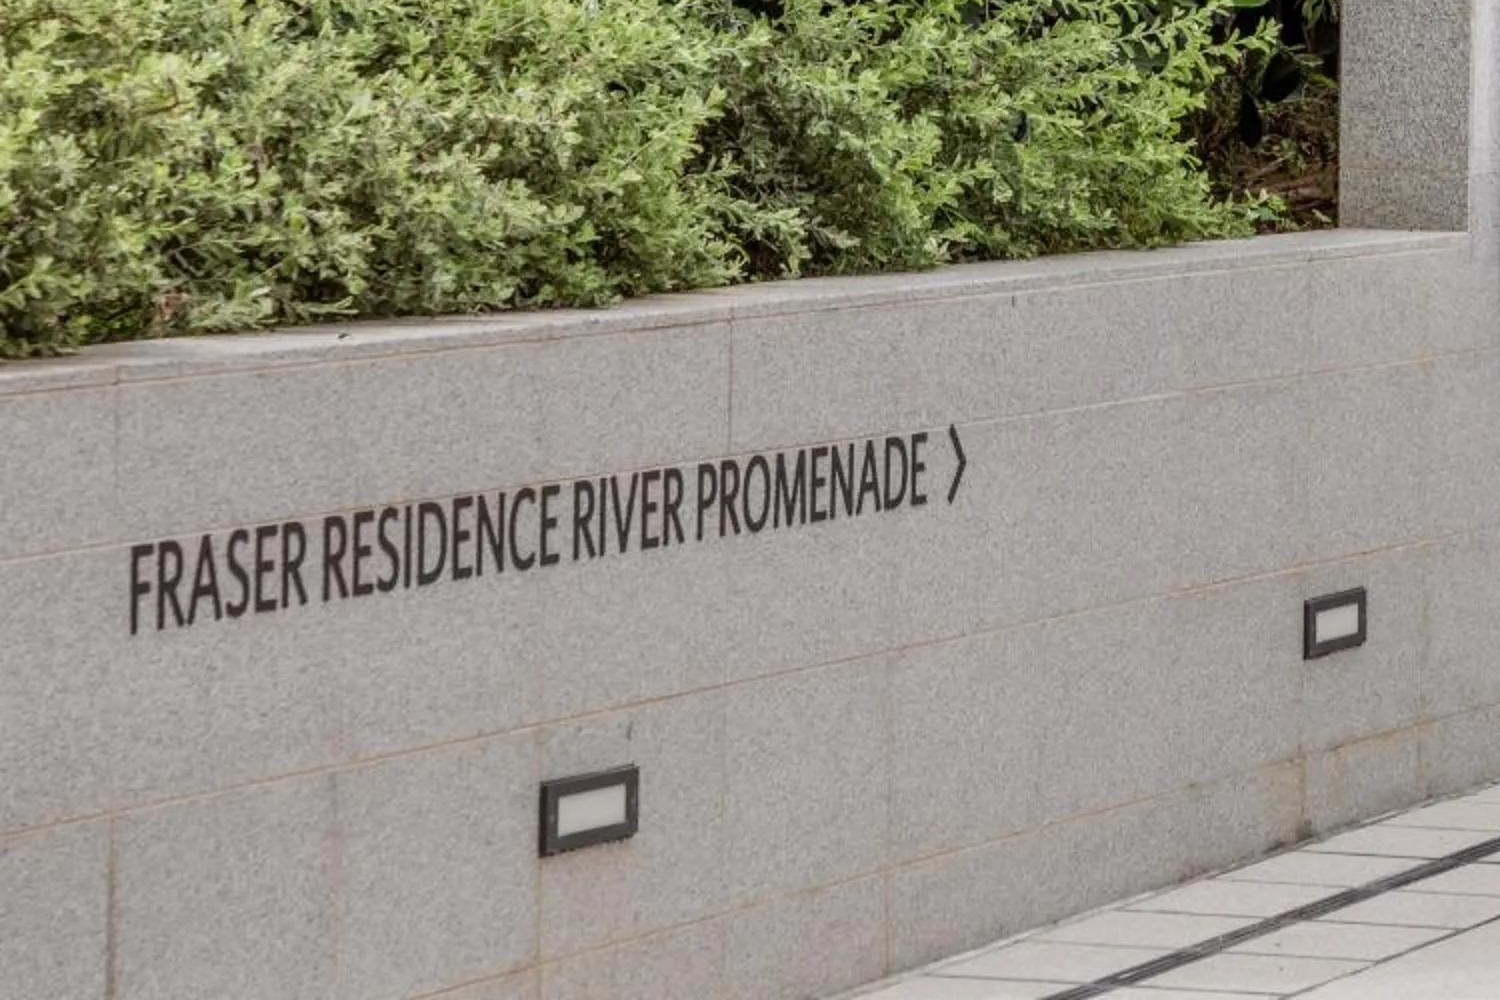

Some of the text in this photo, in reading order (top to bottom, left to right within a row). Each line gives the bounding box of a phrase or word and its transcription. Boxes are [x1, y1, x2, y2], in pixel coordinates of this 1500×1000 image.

[130, 432, 929, 635] FRASER RESIDENCE RIVER PROMENADE
